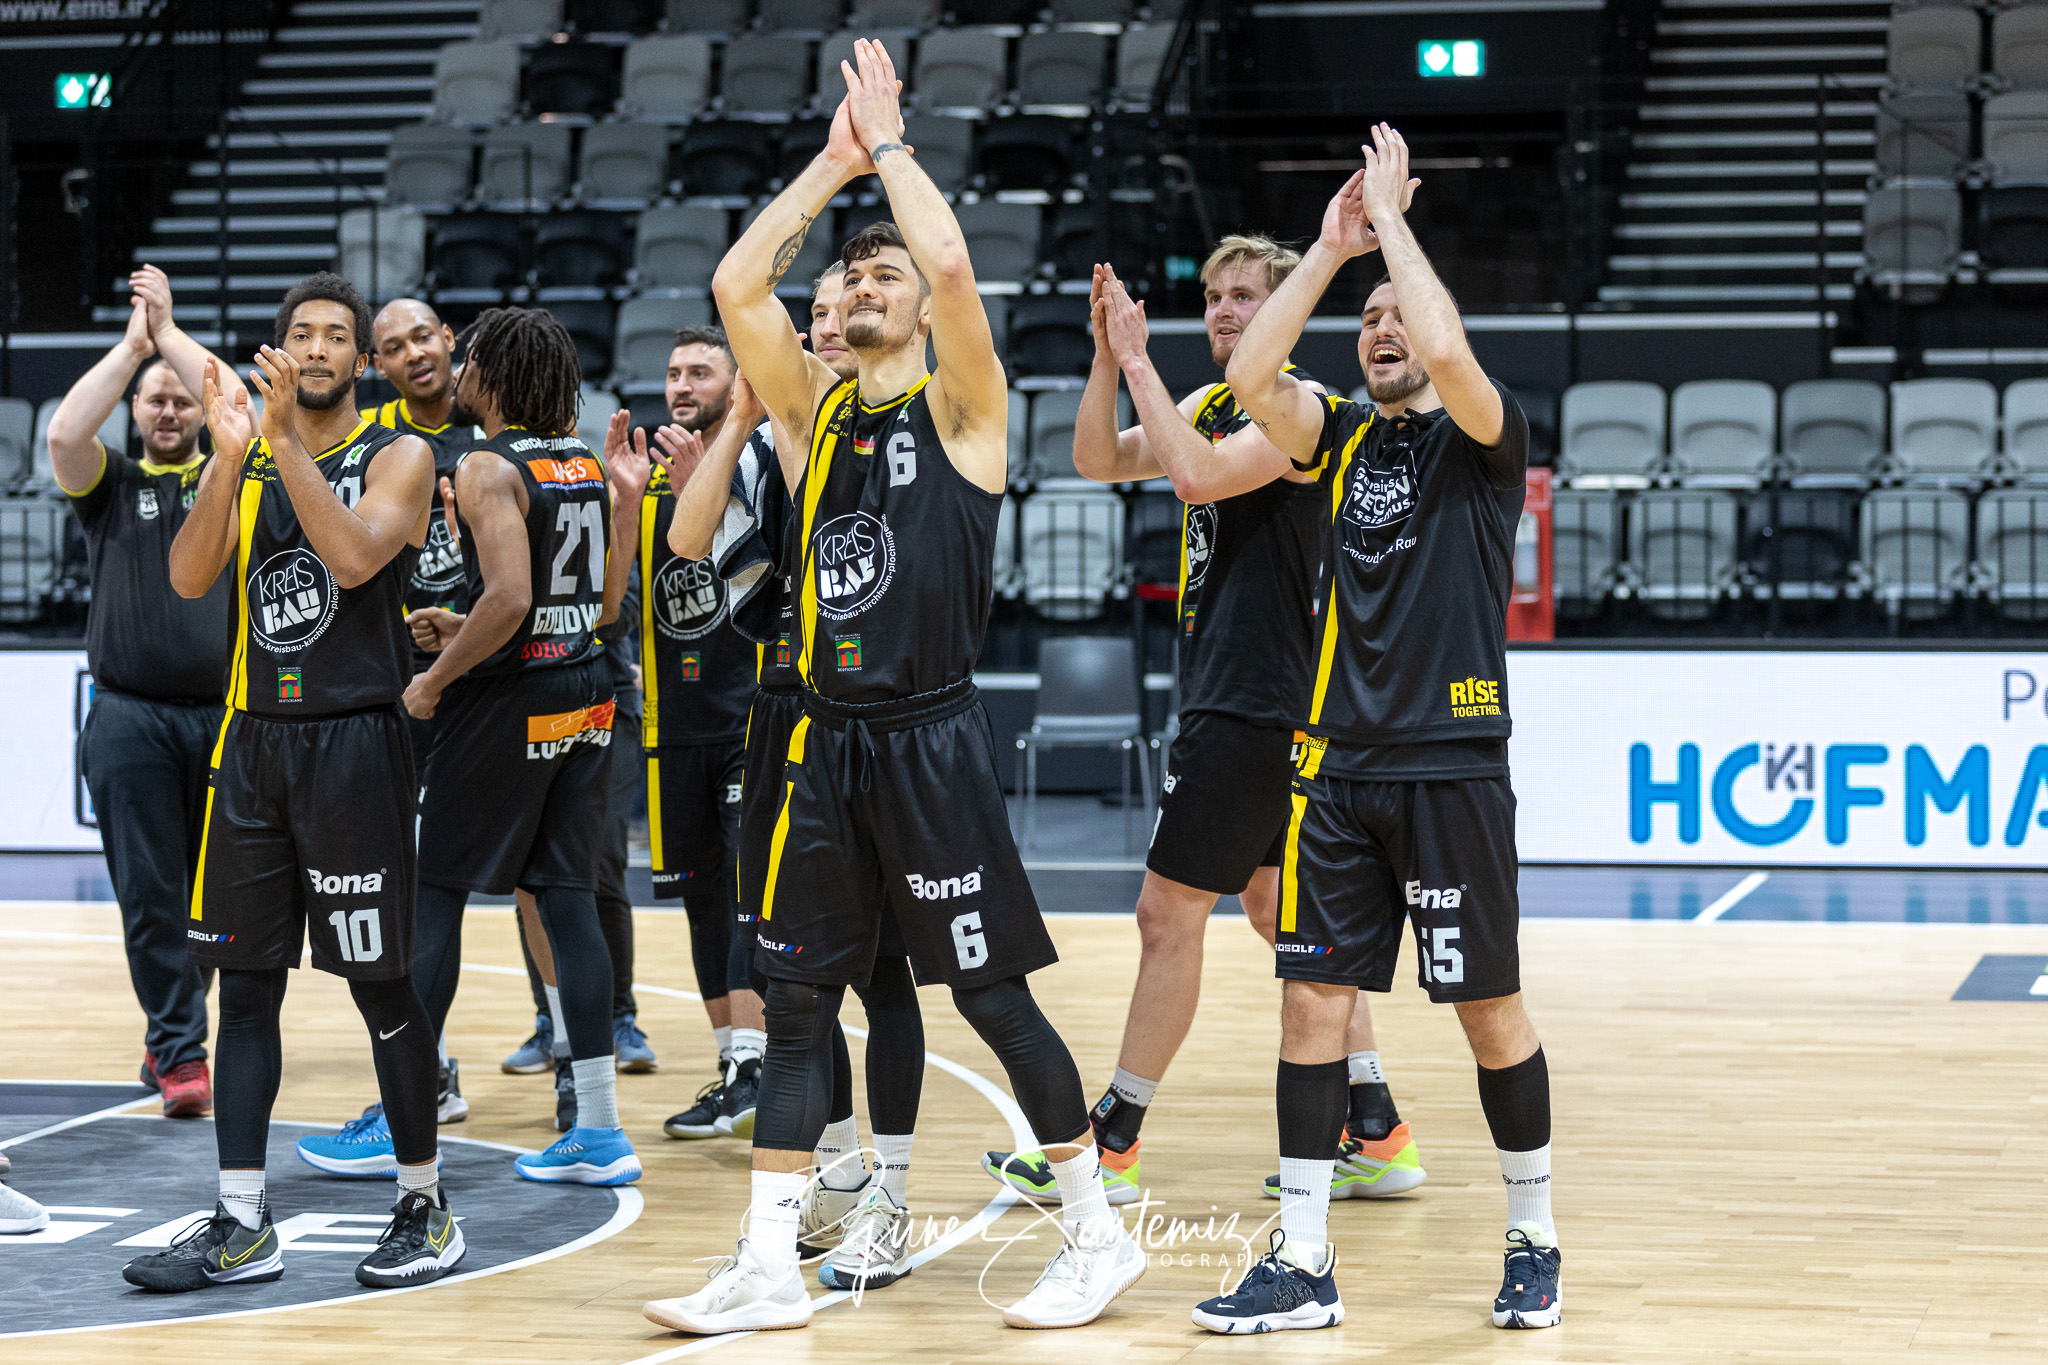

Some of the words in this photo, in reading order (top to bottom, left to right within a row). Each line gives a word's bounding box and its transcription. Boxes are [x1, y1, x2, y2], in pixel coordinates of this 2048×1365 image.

[886, 432, 917, 488] 6
[550, 501, 604, 595] 21
[820, 521, 875, 566] KREIS
[1396, 537, 1417, 551] Rau
[259, 557, 314, 603] KREIS
[661, 560, 712, 599] KREIS
[820, 552, 876, 600] BAU
[262, 588, 320, 634] BAU
[667, 585, 717, 625] BAU
[1450, 677, 1499, 705] RISE
[1452, 705, 1501, 718] TOGETHER
[2003, 668, 2048, 722] P
[187, 930, 219, 942] OSOLF
[328, 908, 383, 962] 10
[950, 911, 989, 970] 6
